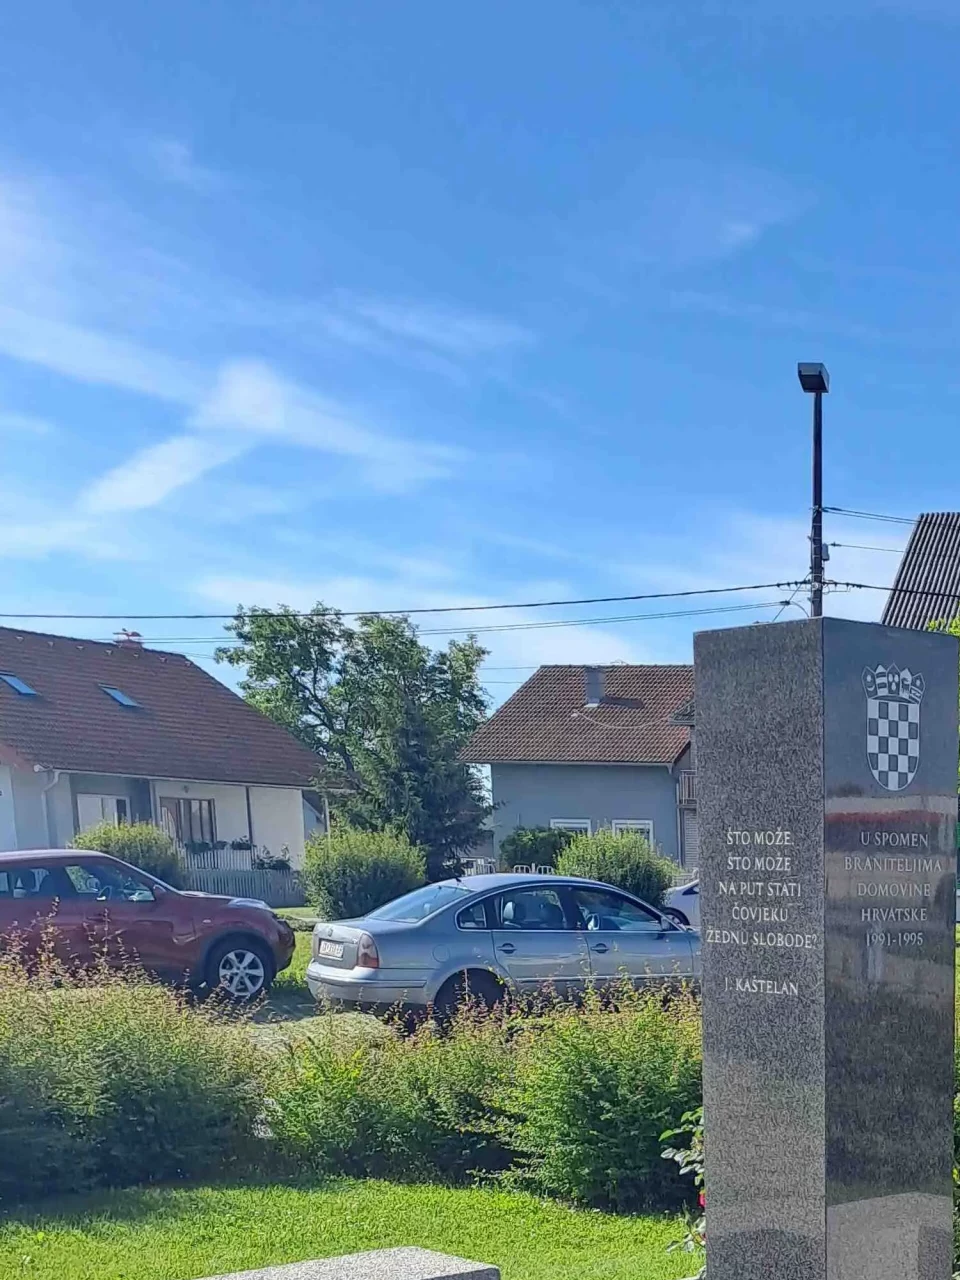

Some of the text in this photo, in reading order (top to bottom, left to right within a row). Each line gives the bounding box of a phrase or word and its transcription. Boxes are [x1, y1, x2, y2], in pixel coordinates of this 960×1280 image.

[726, 826, 751, 845] ŠTO
[861, 831, 929, 848] U SPOMEN
[726, 852, 792, 871] ŠTO MOŽE
[844, 856, 942, 874] BRANITELJIMA
[719, 881, 801, 897] NA PUT STATI
[857, 882, 931, 897] DOMOVINE
[732, 901, 789, 923] ČOVJEKU
[861, 908, 928, 922] HRVATSKE
[706, 925, 818, 949] ŽEDNU SLOBODE?
[866, 932, 924, 947] 1991-1995
[724, 975, 799, 996] J. KAŠTELAN
